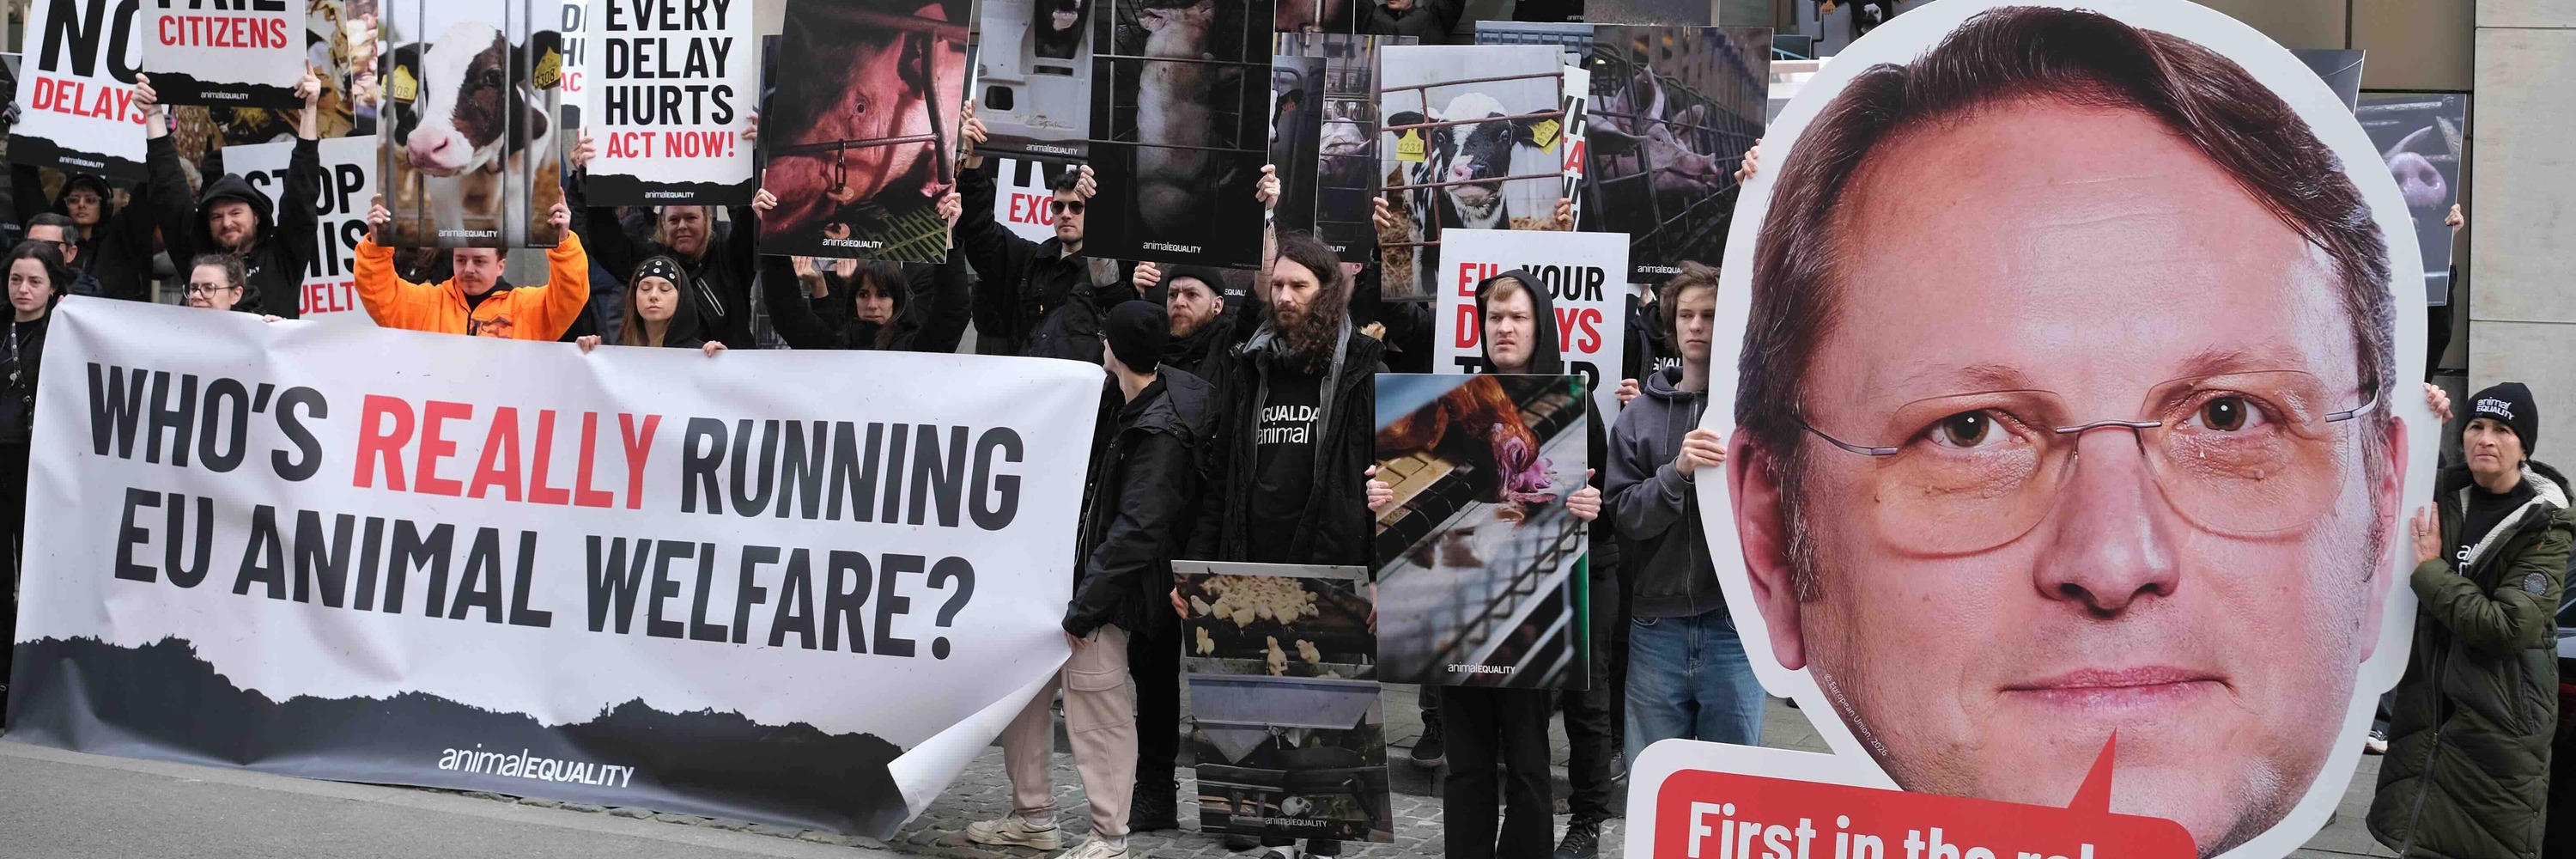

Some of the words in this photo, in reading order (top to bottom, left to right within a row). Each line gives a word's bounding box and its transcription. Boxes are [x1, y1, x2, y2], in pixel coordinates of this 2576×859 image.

[606, 0, 730, 31] EVERY
[39, 0, 143, 84] NO
[159, 15, 287, 49] CITIZENS
[605, 37, 733, 79] DELAY
[201, 91, 249, 100] animalEQUALITY
[605, 84, 734, 125] HURTS
[606, 132, 656, 158] ACT
[665, 131, 734, 158] NOW!
[1026, 143, 1078, 155] animalEQUALITY
[1397, 142, 1422, 152] 4231
[59, 155, 105, 168] animalEQUALITY
[439, 228, 498, 238] animalEQUALITY
[823, 238, 883, 248] animalEQUALITY
[1143, 241, 1201, 254] animalEQUALITY
[2476, 397, 2512, 411] animal
[2476, 405, 2515, 420] EQUALITY
[1257, 422, 1309, 445] animal
[88, 362, 327, 481] WHO'S
[353, 393, 662, 510] REALLY
[680, 417, 1024, 531] RUNNING
[115, 488, 214, 588] EU
[233, 504, 552, 628] ANIMAL
[586, 535, 975, 660] WELFARE?
[1448, 661, 1516, 673] animalEQUALITY
[1829, 680, 1855, 716] European
[1853, 715, 1872, 740] Union,
[1870, 738, 1888, 757] 2026
[438, 743, 635, 788] animalEQUALITY
[1265, 816, 1327, 828] animalEQUALITY
[1687, 801, 1816, 859] First
[1836, 814, 1885, 859] in
